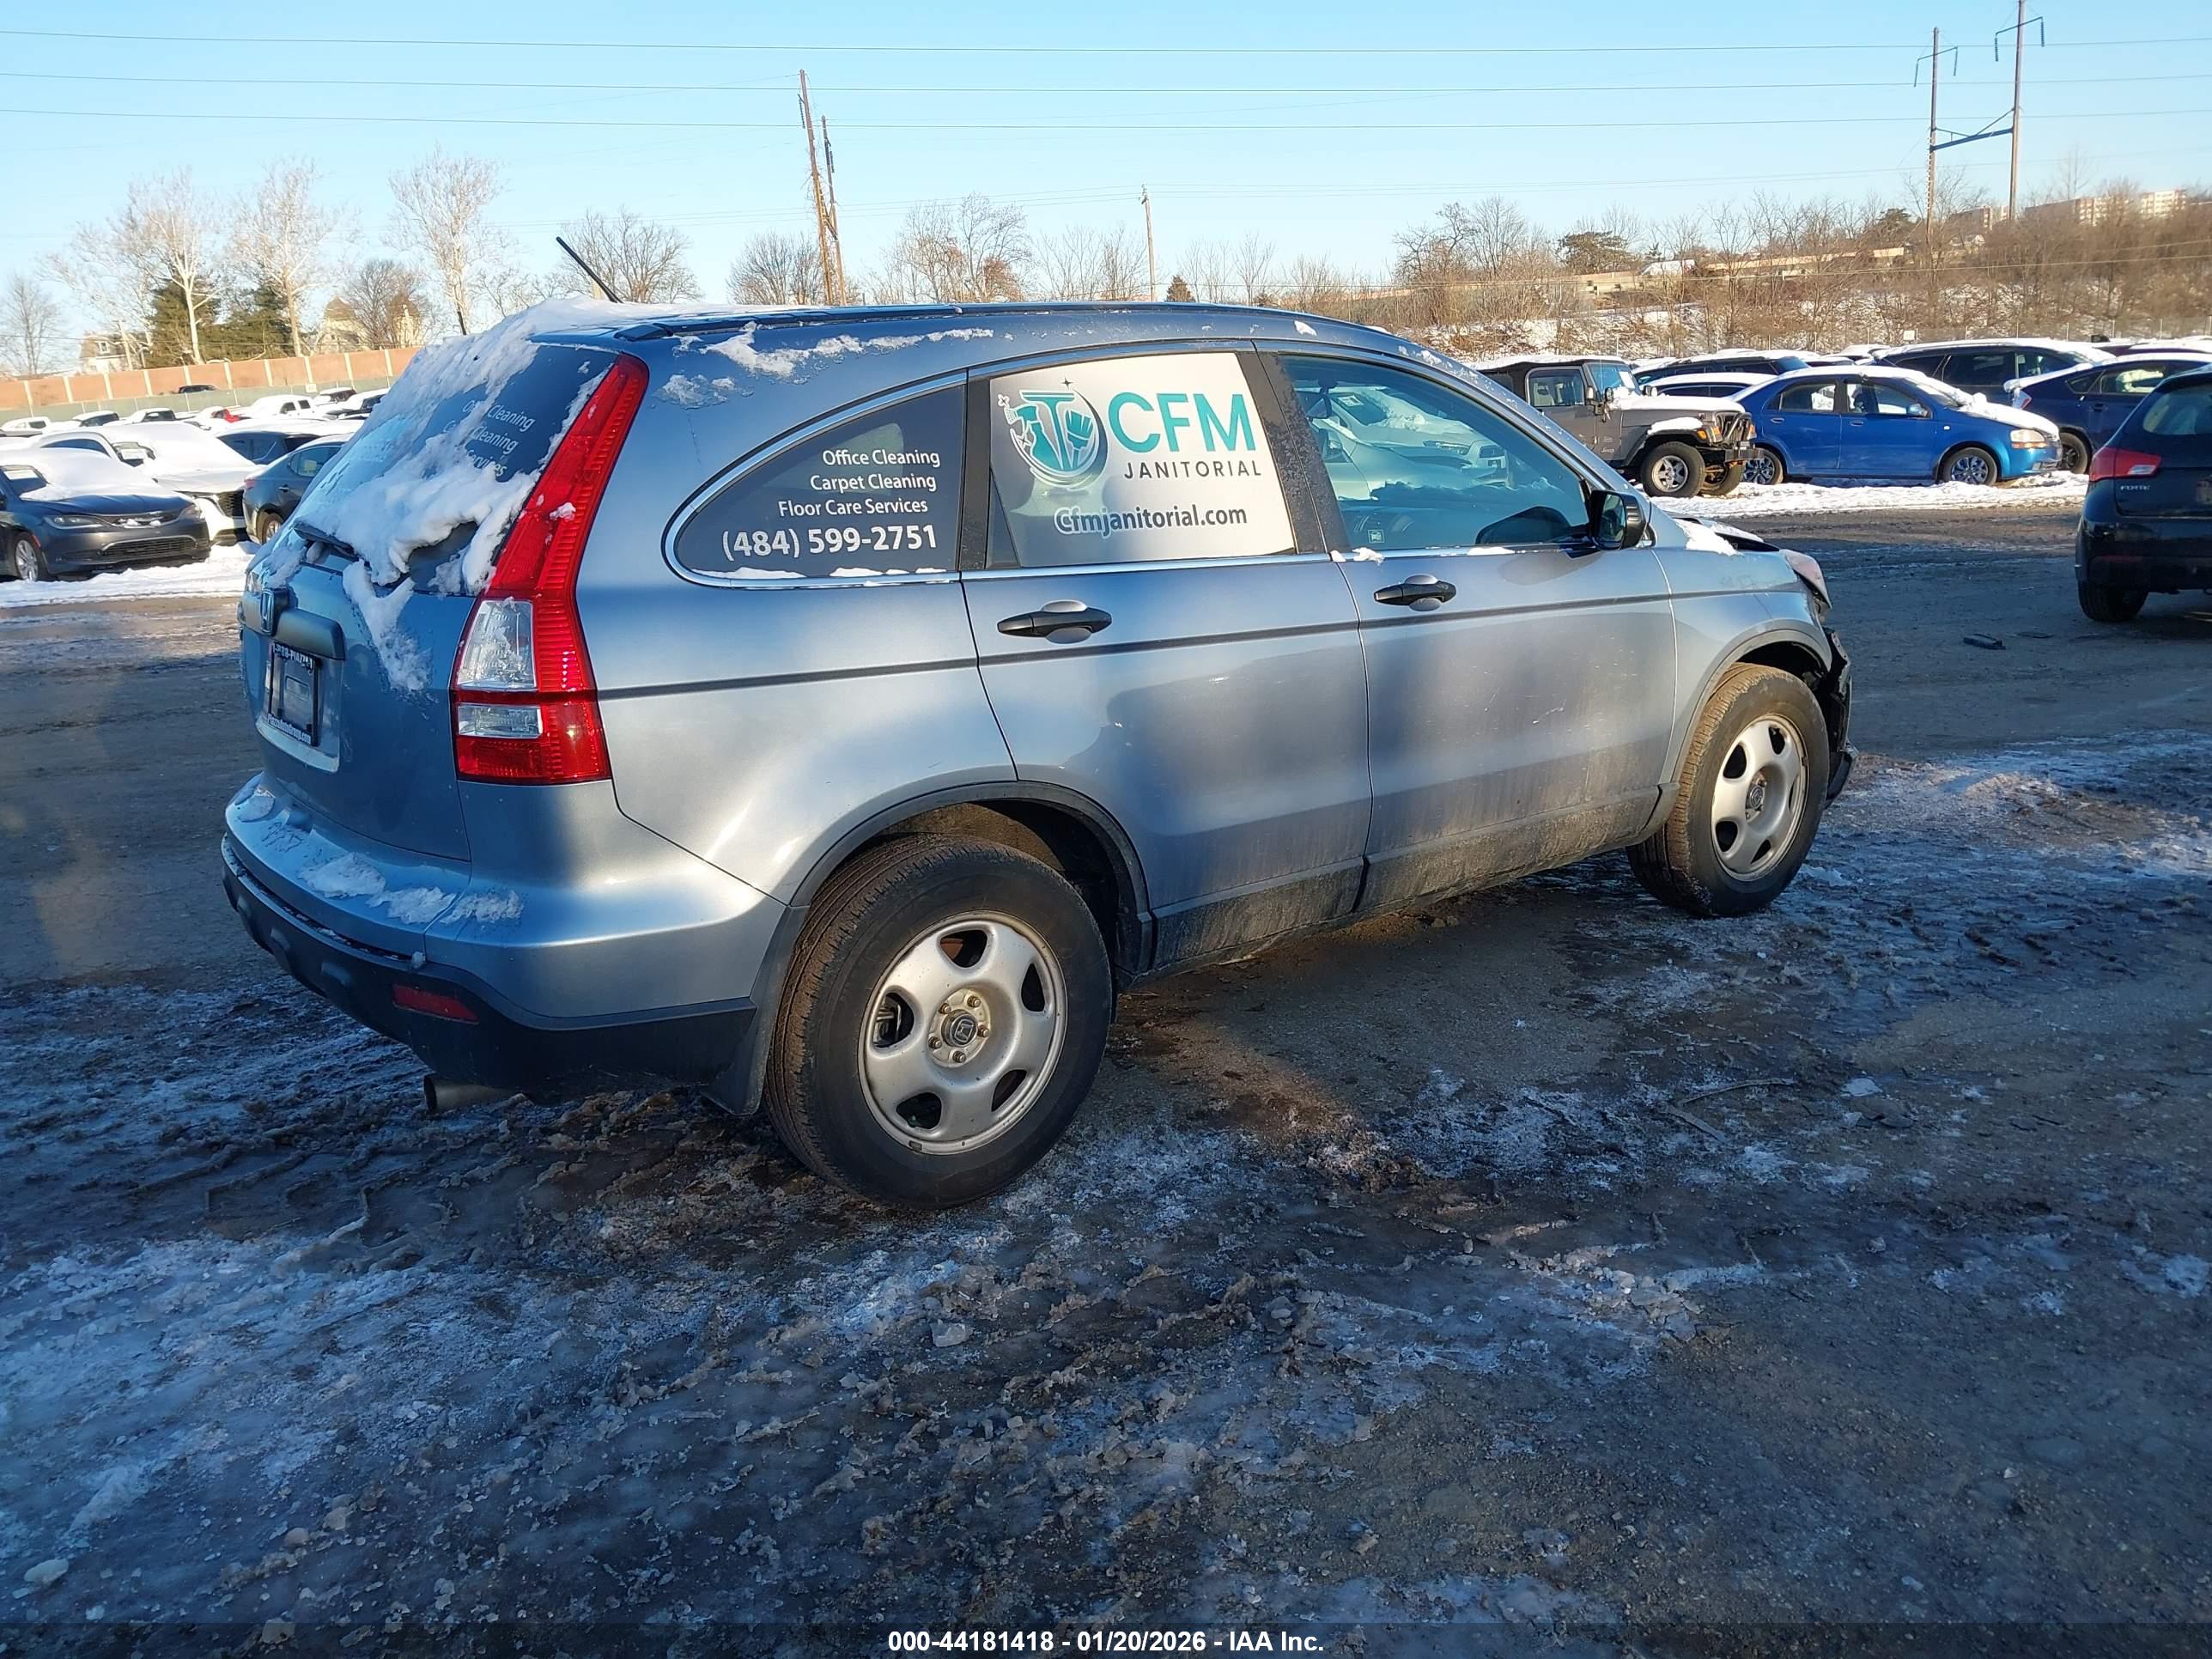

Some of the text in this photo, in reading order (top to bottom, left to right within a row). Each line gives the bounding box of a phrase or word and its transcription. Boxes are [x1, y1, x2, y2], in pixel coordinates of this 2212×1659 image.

[487, 404, 536, 432] Cleaning
[1109, 392, 1255, 453] CFM
[471, 425, 520, 454] Cleaning
[823, 449, 940, 468] Office Cleaning
[1124, 460, 1261, 479] JANITORIAL
[810, 473, 937, 494] Carpet Cleaning
[778, 497, 928, 517] Floor Care Services
[1054, 504, 1248, 538] Cfmjanitorial.com
[722, 524, 937, 562] (484) 599-2751
